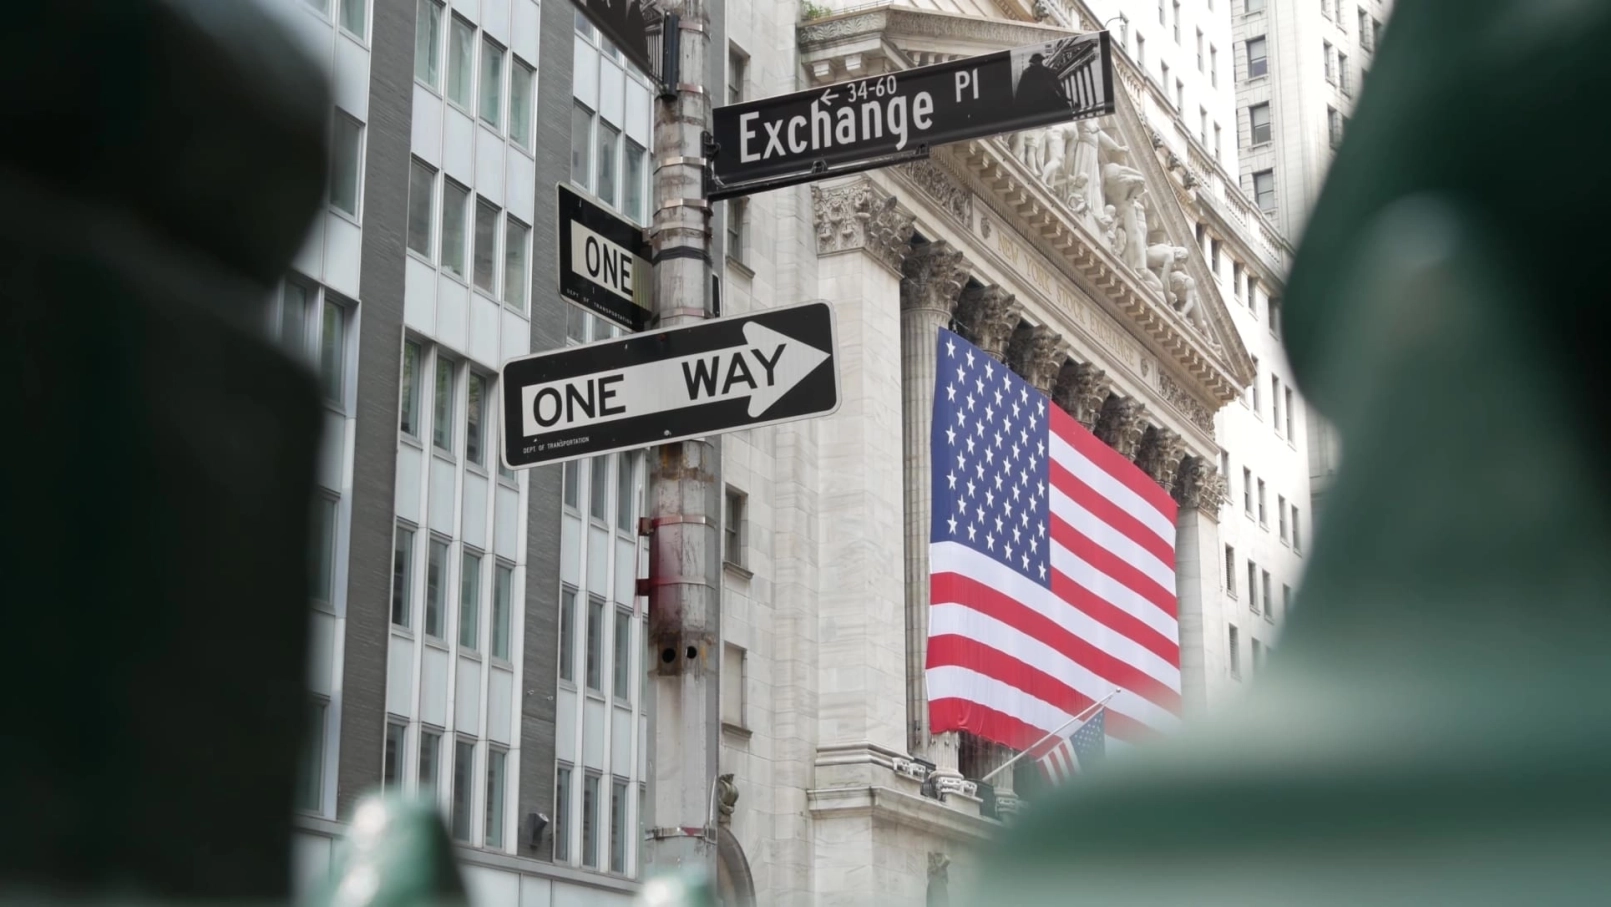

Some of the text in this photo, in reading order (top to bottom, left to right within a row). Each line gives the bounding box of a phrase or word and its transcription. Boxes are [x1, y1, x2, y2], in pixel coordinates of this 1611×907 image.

[739, 68, 979, 163] Exchange Pl
[847, 75, 897, 103] 34-60
[585, 235, 634, 297] ONE
[998, 230, 1019, 265] NEW
[1025, 256, 1051, 295] YORK
[1057, 285, 1086, 324] STOCK
[593, 301, 633, 325] TRANSPORTATION
[533, 343, 787, 428] ONE WAY
[547, 436, 590, 449] TRANSPORTATION
